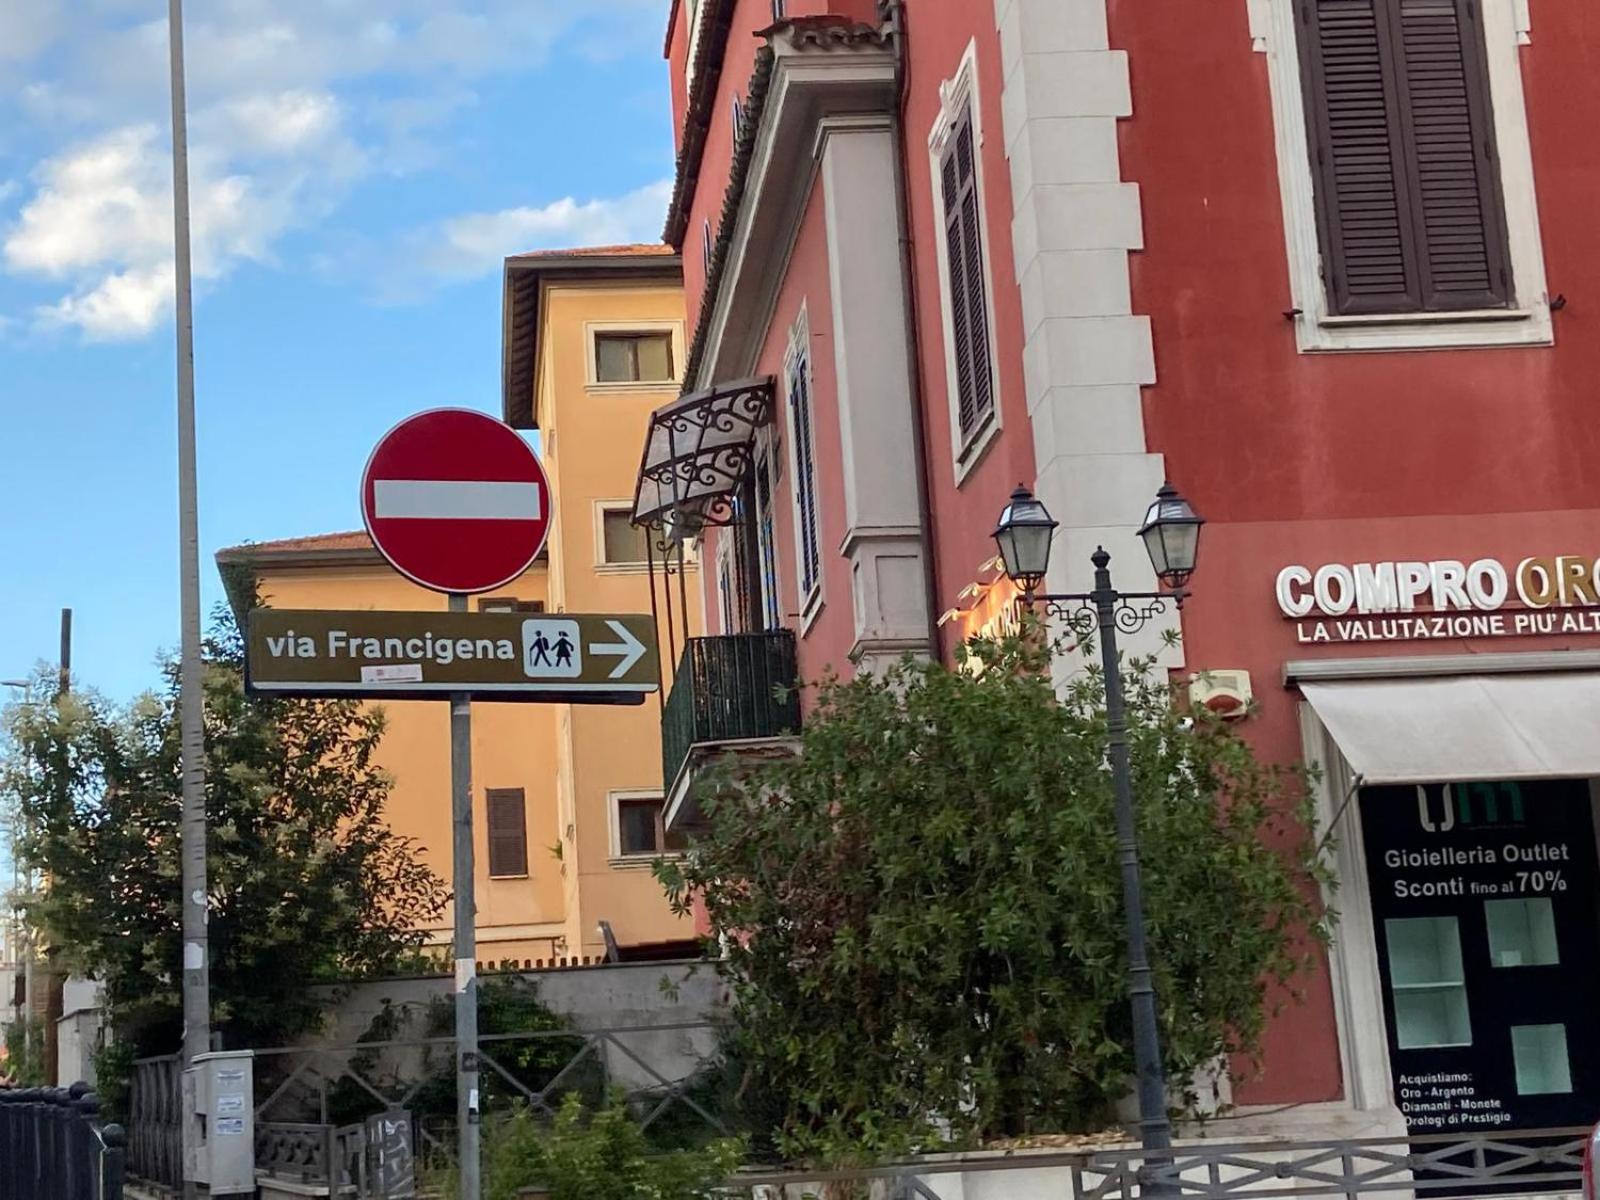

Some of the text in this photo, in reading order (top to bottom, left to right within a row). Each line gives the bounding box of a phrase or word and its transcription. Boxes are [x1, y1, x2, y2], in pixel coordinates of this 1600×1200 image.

[1276, 555, 1600, 617] COMPRO OR
[1297, 622, 1330, 642] LA
[1336, 615, 1505, 640] VALUTAZIONE
[1514, 612, 1557, 634] PIU'
[267, 630, 515, 664] via Francigena
[1384, 843, 1570, 868] Gioielleria Outlet
[1394, 870, 1568, 898] Sconti fino al 70%
[1399, 1072, 1473, 1086] Acquistiamo:
[1400, 1088, 1422, 1099] Oro
[1431, 1086, 1475, 1099] Argento
[1402, 1101, 1451, 1113] Diamanti
[1461, 1099, 1501, 1110] Monete
[1405, 1112, 1512, 1127] Orologi di Prestigio
